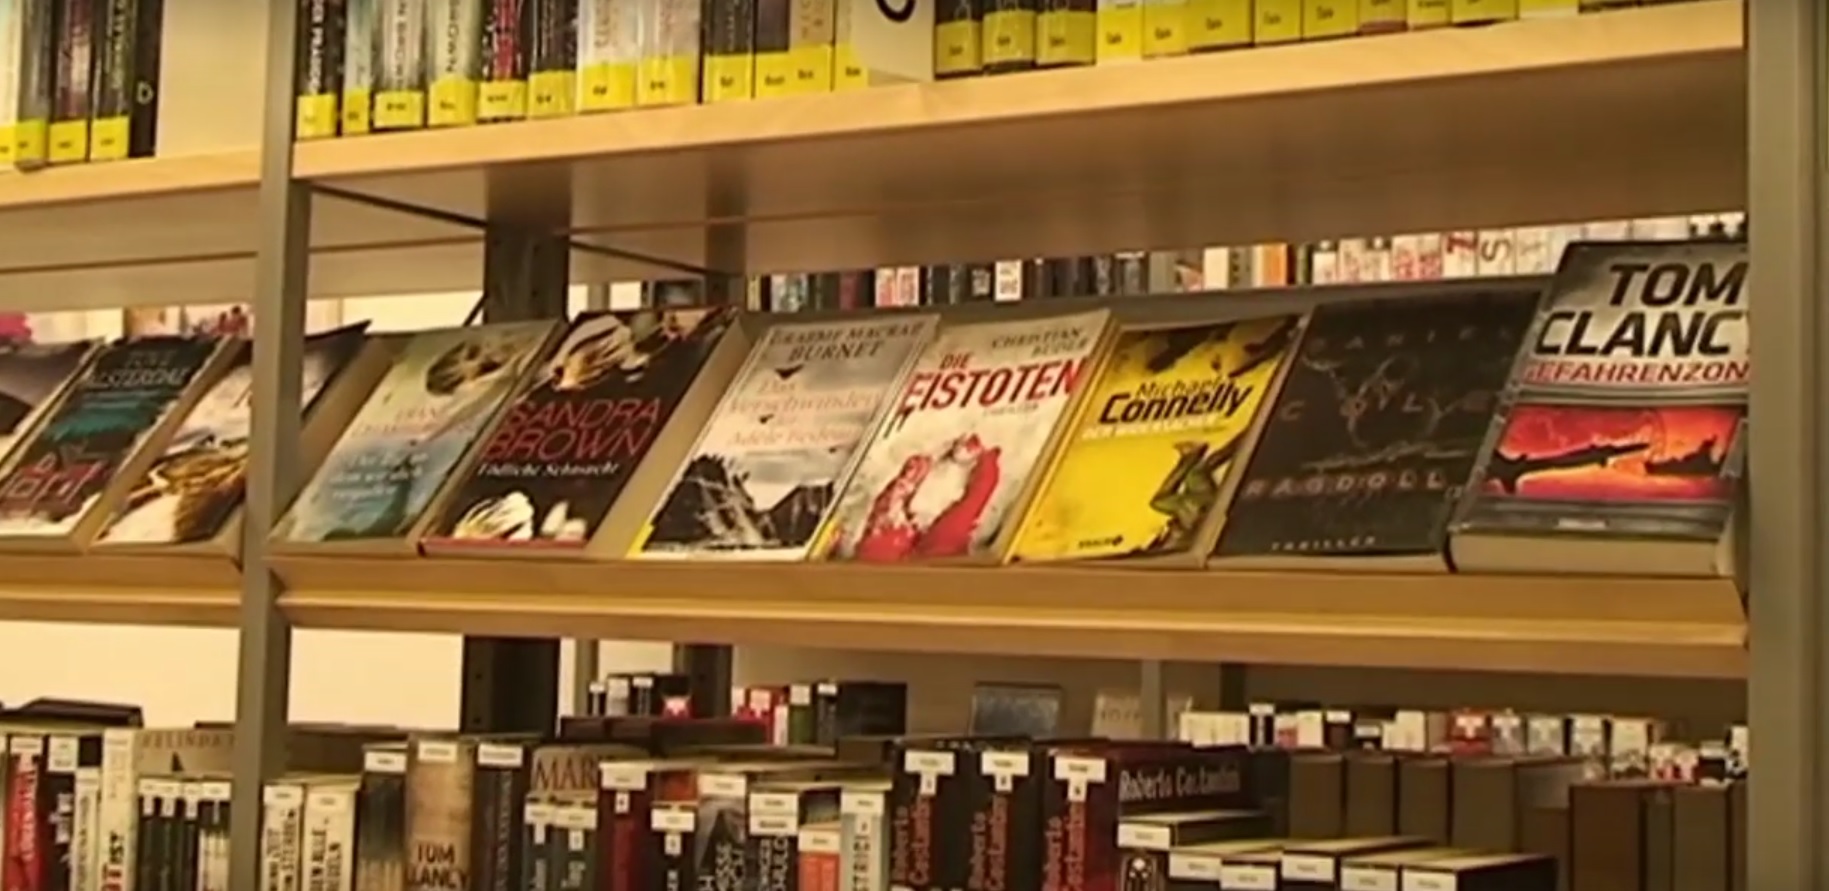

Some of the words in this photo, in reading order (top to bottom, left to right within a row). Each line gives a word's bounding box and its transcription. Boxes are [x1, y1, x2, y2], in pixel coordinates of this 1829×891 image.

[1608, 261, 1748, 306] TOM
[787, 340, 885, 362] BURNET
[1533, 310, 1749, 358] CLANC
[940, 351, 974, 370] DIE
[897, 357, 1091, 415] EISTOTEN
[1136, 374, 1223, 399] Michael
[505, 398, 661, 428] SANDRA
[1098, 383, 1255, 425] Connelly
[480, 427, 654, 462] BROWN
[1243, 469, 1448, 497] RAGDOLL
[1118, 767, 1174, 803] Roberto
